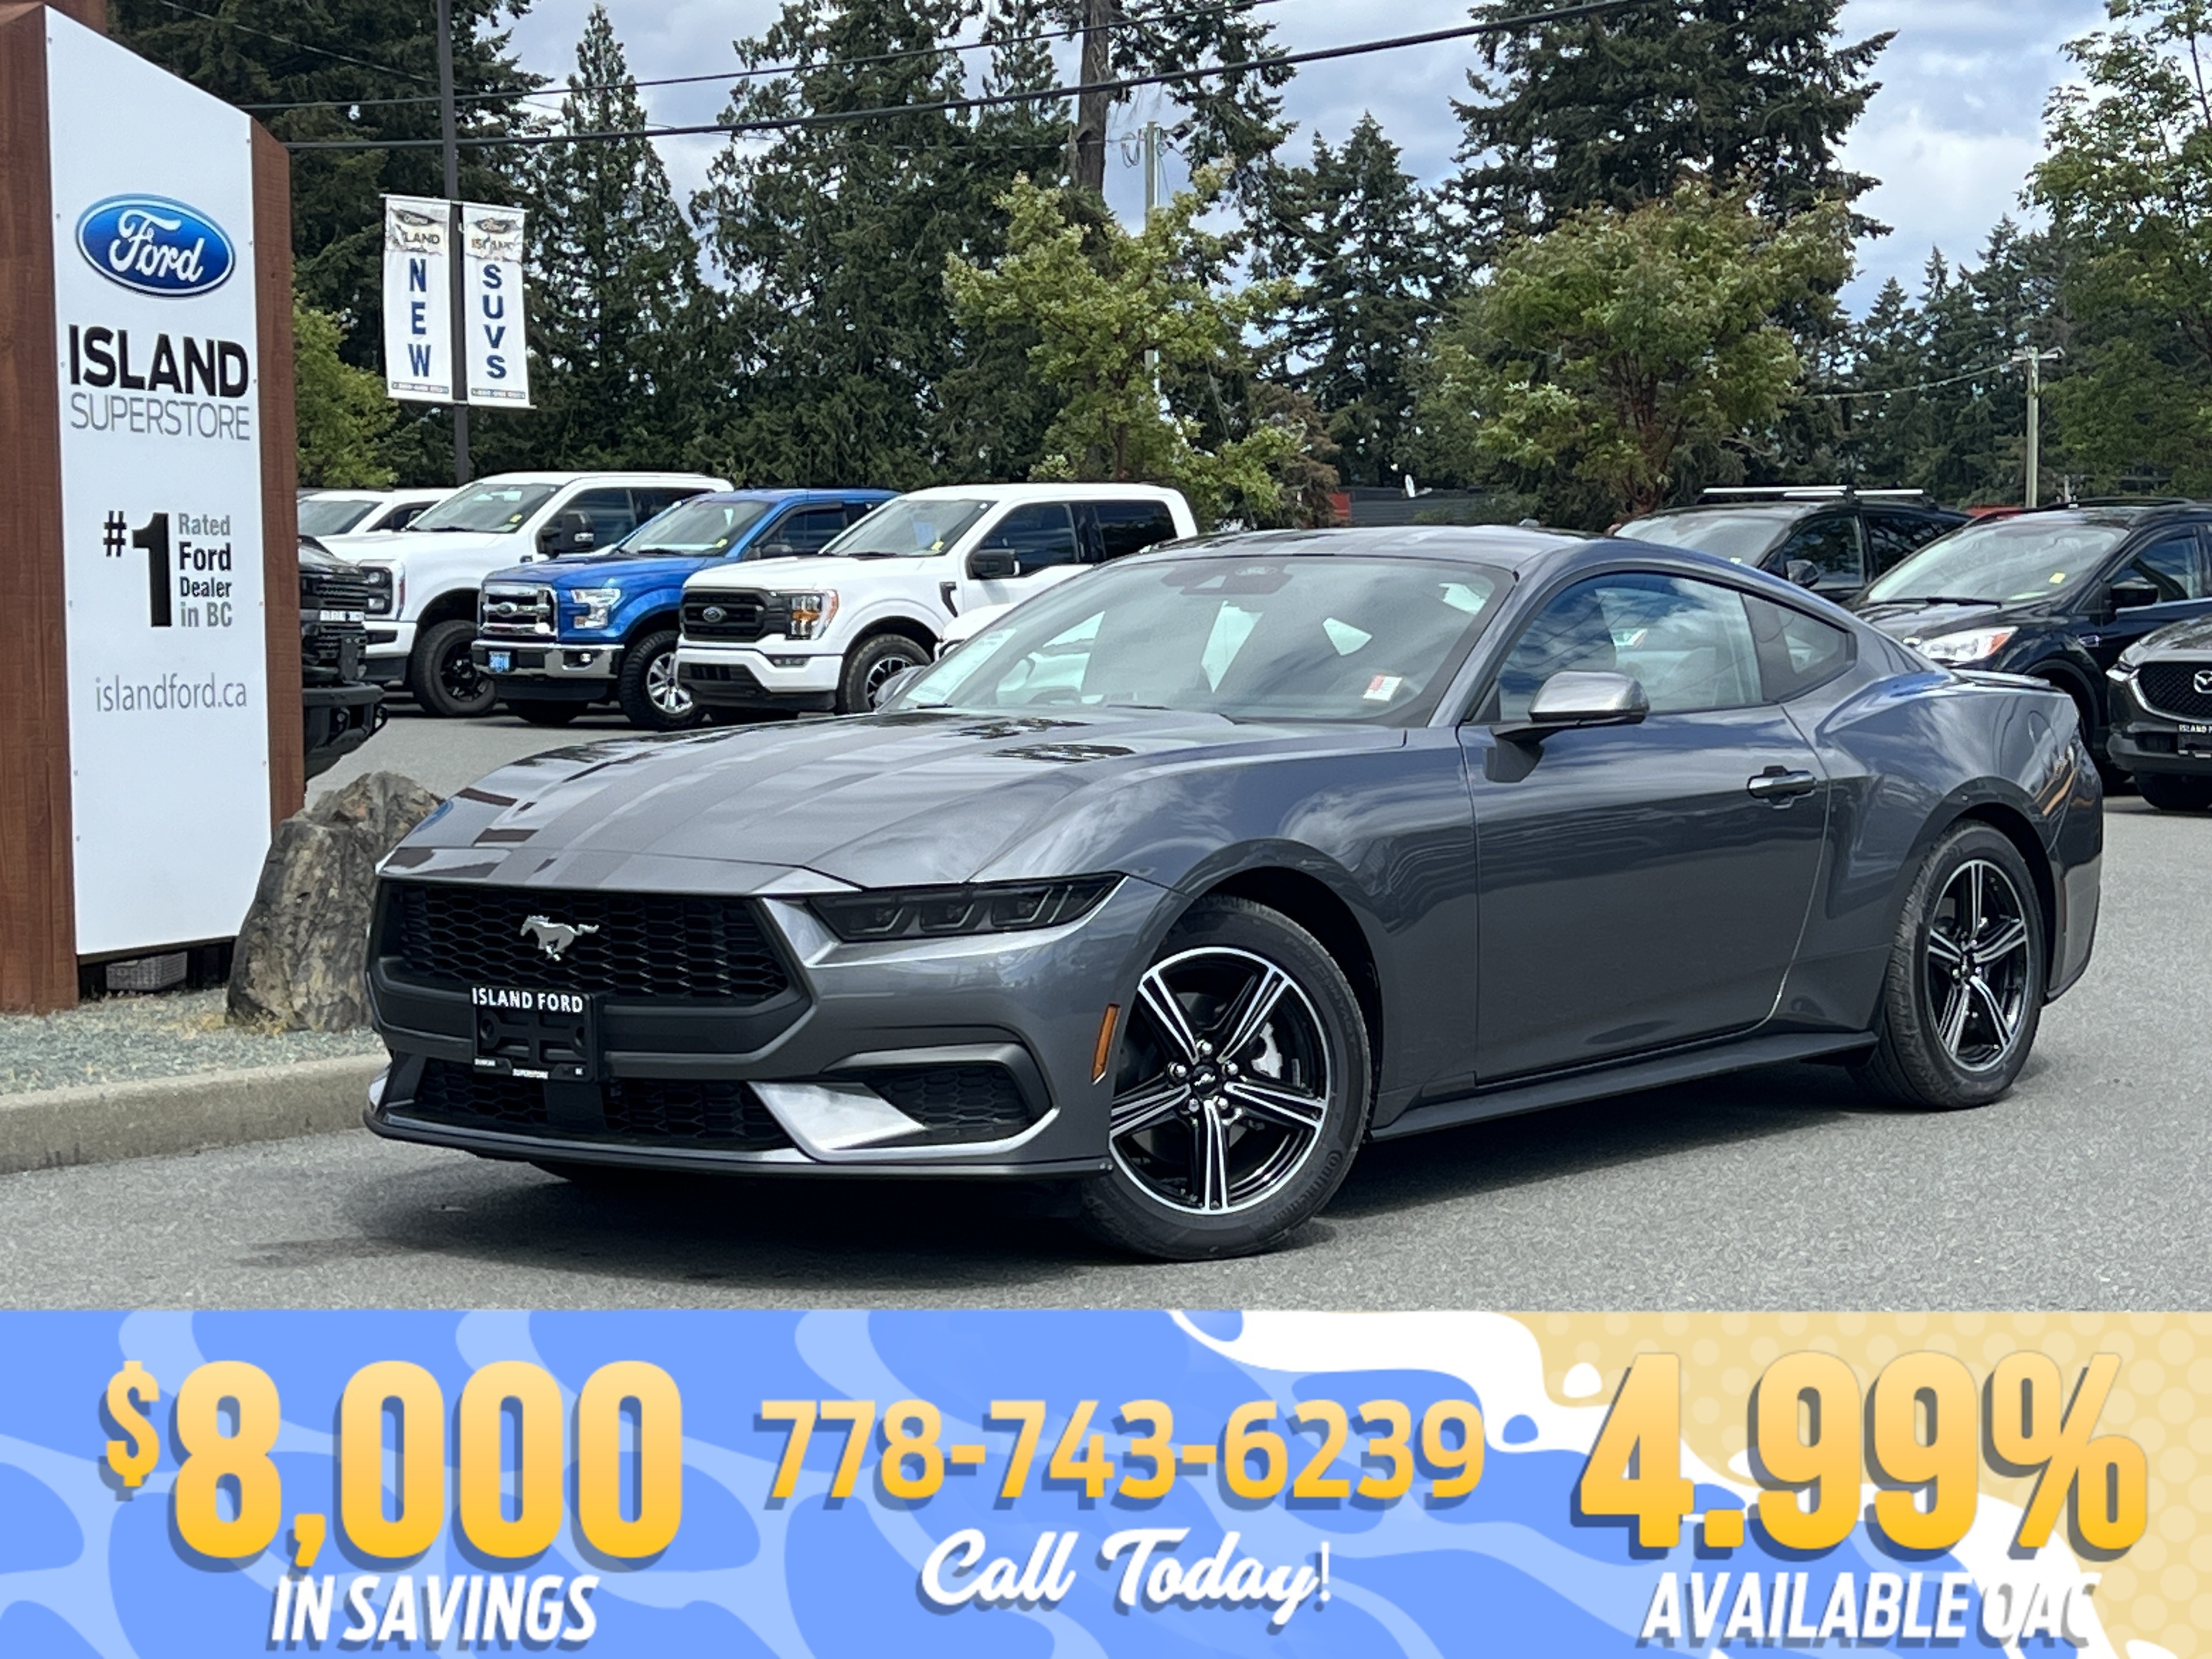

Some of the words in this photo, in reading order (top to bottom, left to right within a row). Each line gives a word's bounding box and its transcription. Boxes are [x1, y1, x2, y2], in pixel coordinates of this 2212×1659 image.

[108, 208, 206, 283] Ford
[407, 257, 432, 378] NEW
[482, 263, 508, 379] SUVS
[68, 323, 250, 399] ISLAND
[70, 391, 251, 442] SUPERSTORE
[177, 512, 231, 537] Rated
[102, 510, 173, 628] #1
[178, 540, 232, 571] Ford
[179, 575, 233, 598] Dealer
[180, 601, 200, 628] in
[206, 601, 233, 628] BC
[95, 672, 247, 713] islandford.ca
[472, 987, 533, 1009] ISLAND
[538, 992, 583, 1013] FORD
